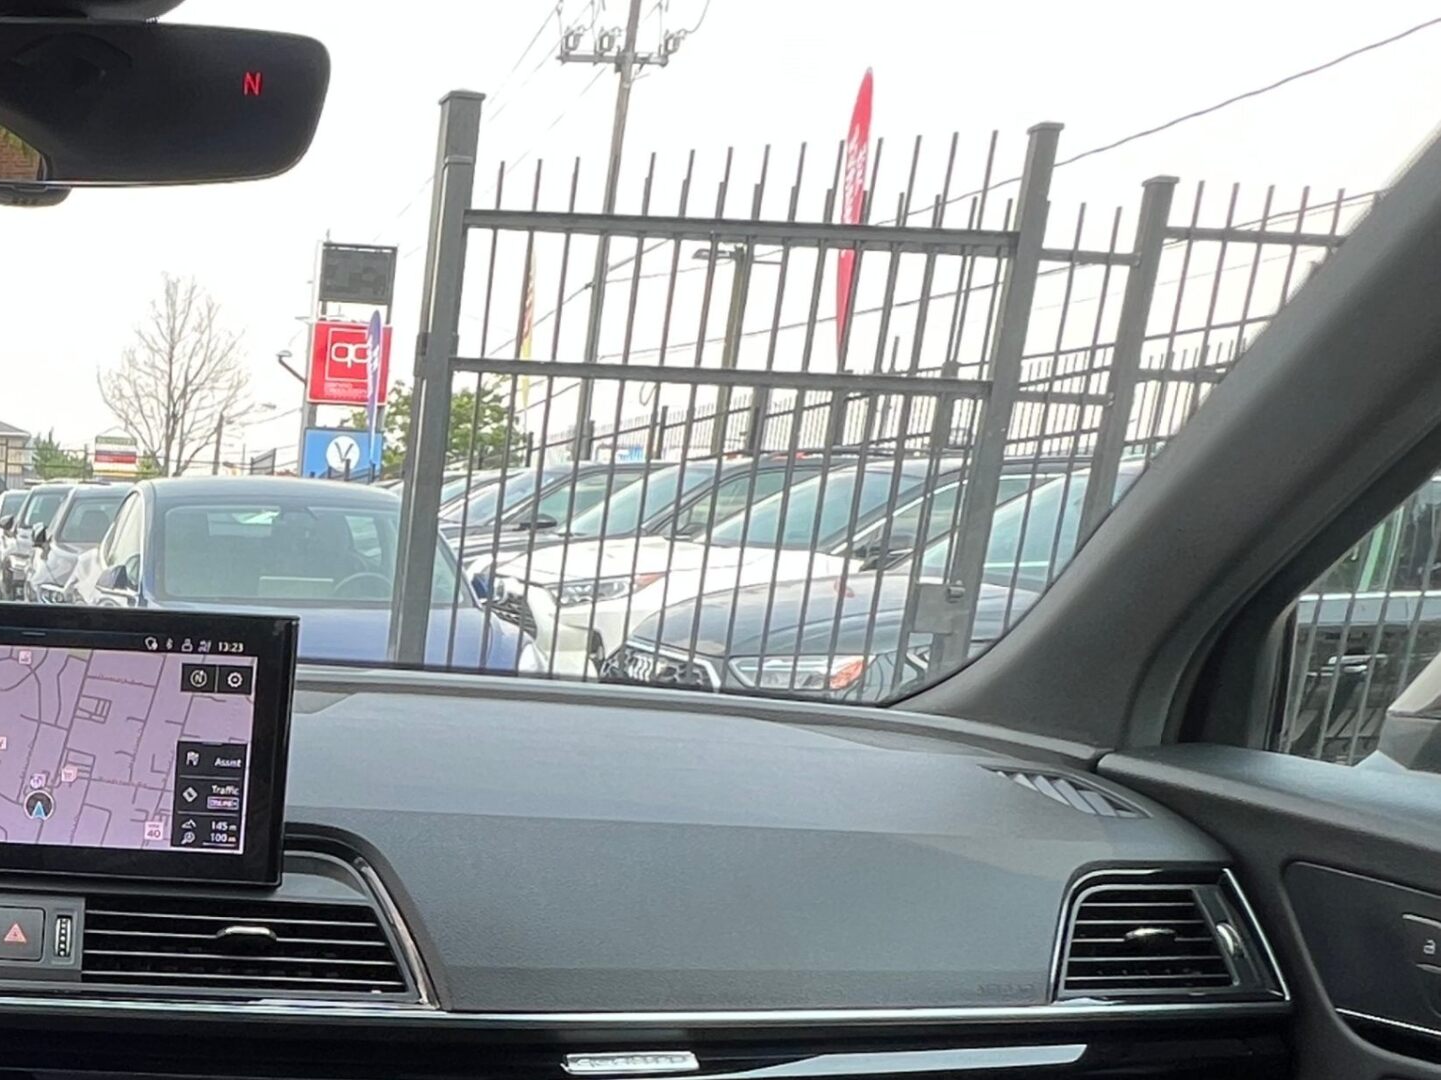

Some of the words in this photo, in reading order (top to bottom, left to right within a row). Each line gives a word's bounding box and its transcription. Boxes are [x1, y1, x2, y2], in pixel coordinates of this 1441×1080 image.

[243, 71, 261, 95] N
[211, 785, 239, 796] Traffic
[211, 821, 228, 831] 145
[147, 830, 161, 838] 40
[210, 832, 227, 842] 100
